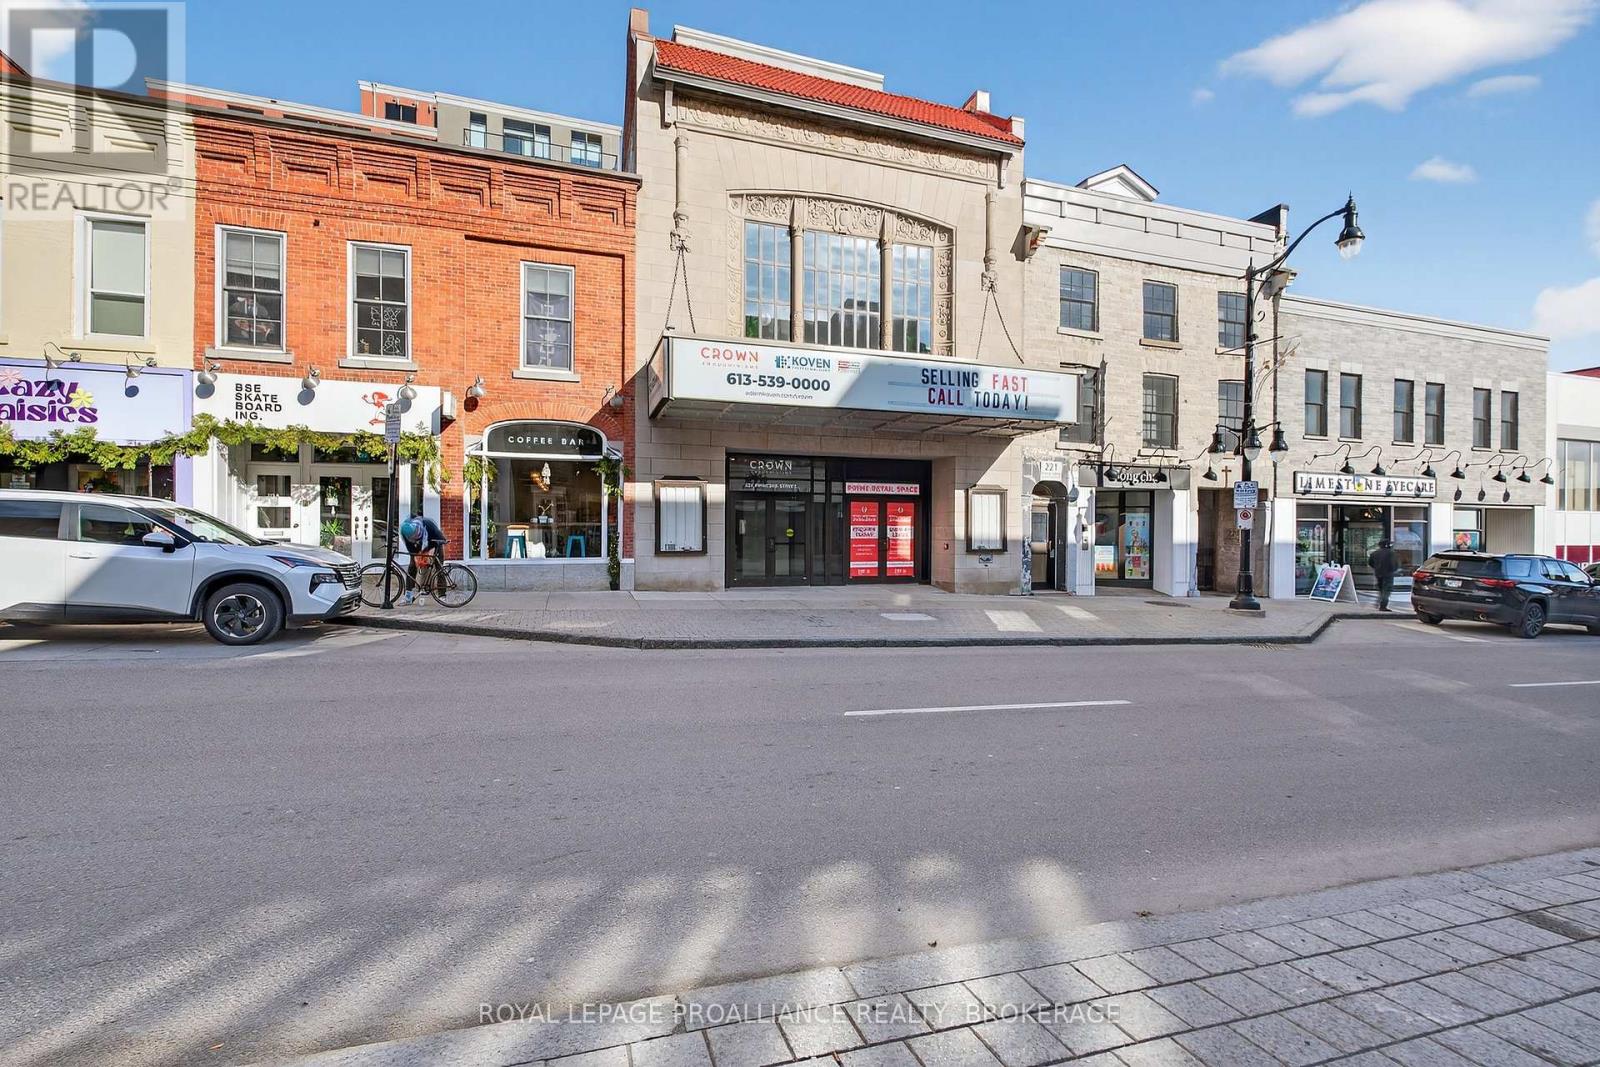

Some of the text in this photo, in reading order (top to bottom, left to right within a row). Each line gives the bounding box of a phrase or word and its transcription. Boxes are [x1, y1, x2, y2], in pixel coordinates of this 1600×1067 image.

[701, 346, 759, 363] CROWN
[792, 355, 831, 369] KOVEN
[727, 373, 830, 392] 613-539-0000
[921, 368, 1028, 392] SELLING FAST
[235, 383, 261, 392] BSE
[235, 392, 278, 403] SKATE
[928, 387, 1028, 411] CALL TODAY!
[0, 398, 98, 423] aisies
[235, 402, 282, 412] BOARD
[235, 411, 263, 420] ING.
[508, 436, 584, 446] COFFEE BAR
[750, 460, 793, 471] CROWN
[1044, 462, 1058, 471] 221
[896, 485, 918, 493] SPACE
[1300, 476, 1434, 493] LIMESTNE EYECARE
